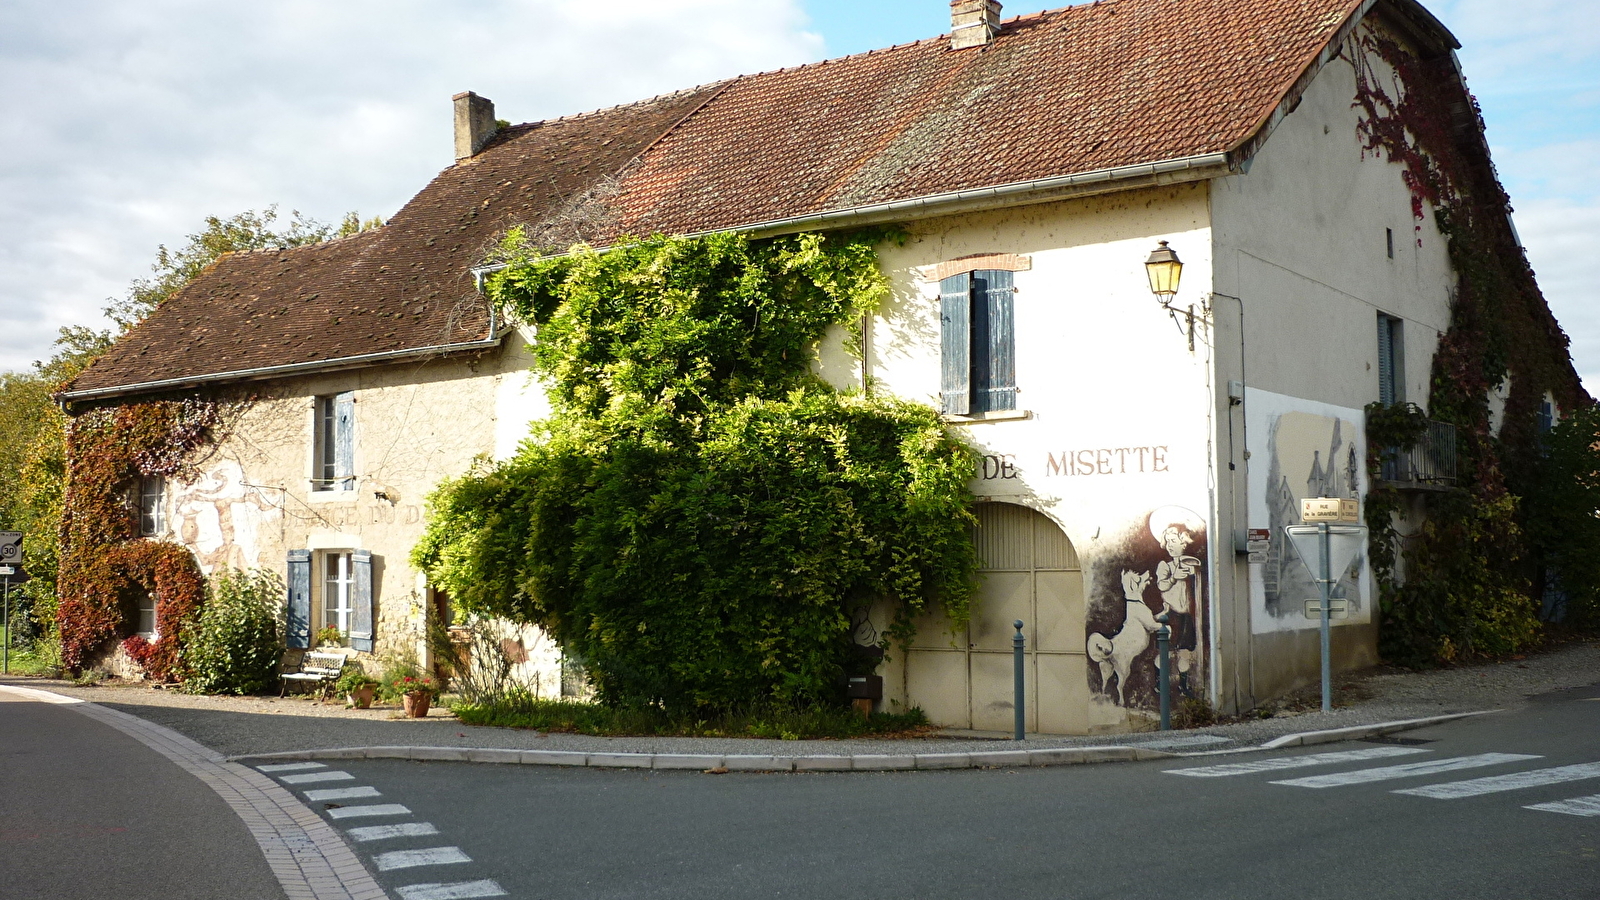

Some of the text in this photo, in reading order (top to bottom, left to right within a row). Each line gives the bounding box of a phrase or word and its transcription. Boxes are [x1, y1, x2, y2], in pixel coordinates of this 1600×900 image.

[982, 445, 1170, 481] DE MISETTE
[271, 504, 359, 531] UBERGE
[367, 505, 396, 525] DU
[4, 547, 15, 555] 30
